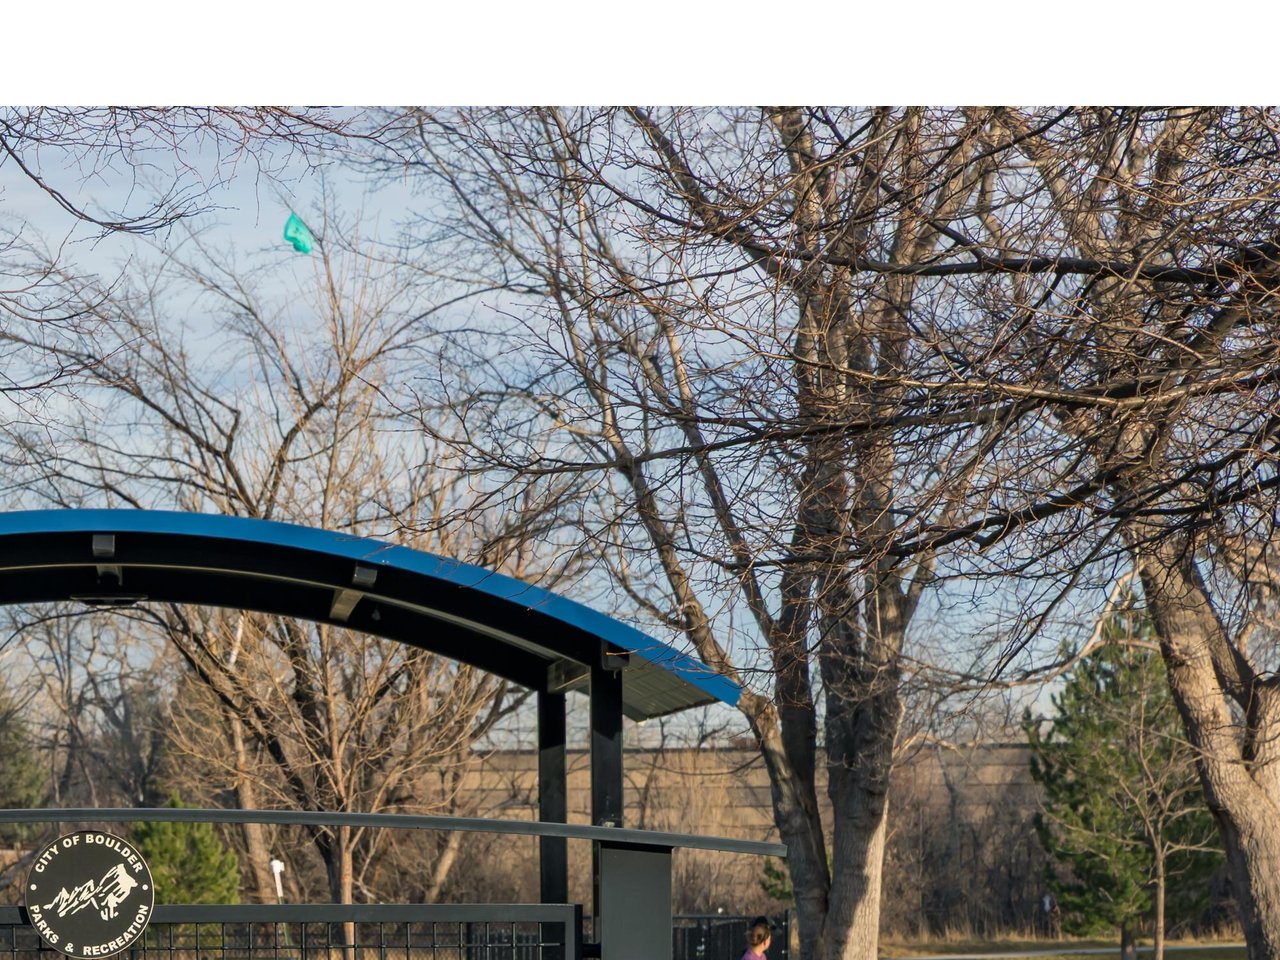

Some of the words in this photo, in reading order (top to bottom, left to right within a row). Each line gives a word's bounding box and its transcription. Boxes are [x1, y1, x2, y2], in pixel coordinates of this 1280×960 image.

[35, 844, 60, 873] CITY
[62, 835, 80, 848] OF
[86, 834, 143, 873] BOULDER
[30, 905, 59, 944] PARKS
[65, 942, 74, 952] &
[83, 904, 149, 955] RECREATION
